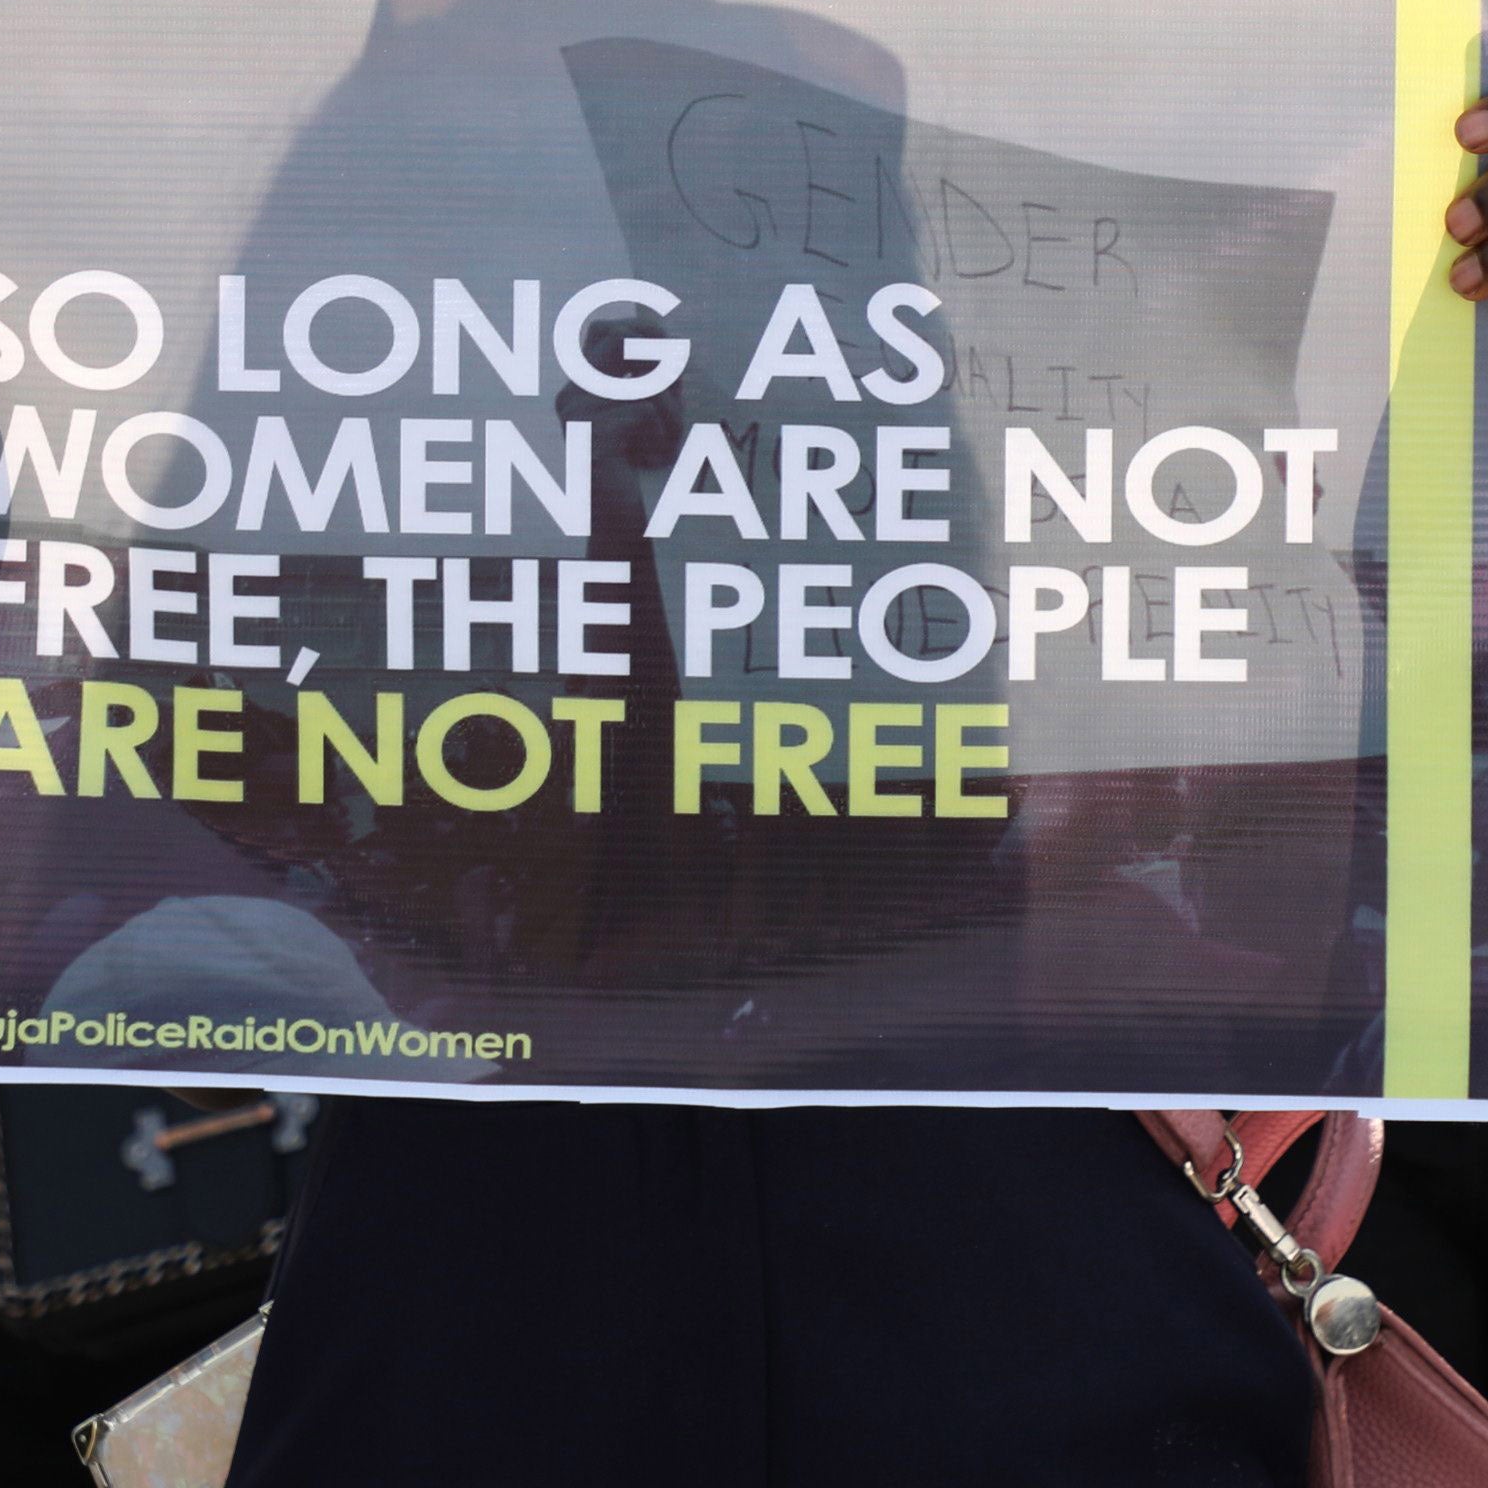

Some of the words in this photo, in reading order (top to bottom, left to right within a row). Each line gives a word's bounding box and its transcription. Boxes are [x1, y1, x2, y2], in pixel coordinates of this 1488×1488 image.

[667, 93, 1140, 297] GENDER
[219, 275, 689, 399] LONG
[736, 284, 943, 404] AS
[646, 424, 949, 541] ARE
[1005, 426, 1338, 546] NOT
[365, 558, 629, 674] THE
[687, 564, 1248, 682] PEOPLE
[299, 693, 624, 811] NOT
[675, 701, 1008, 816] FREE
